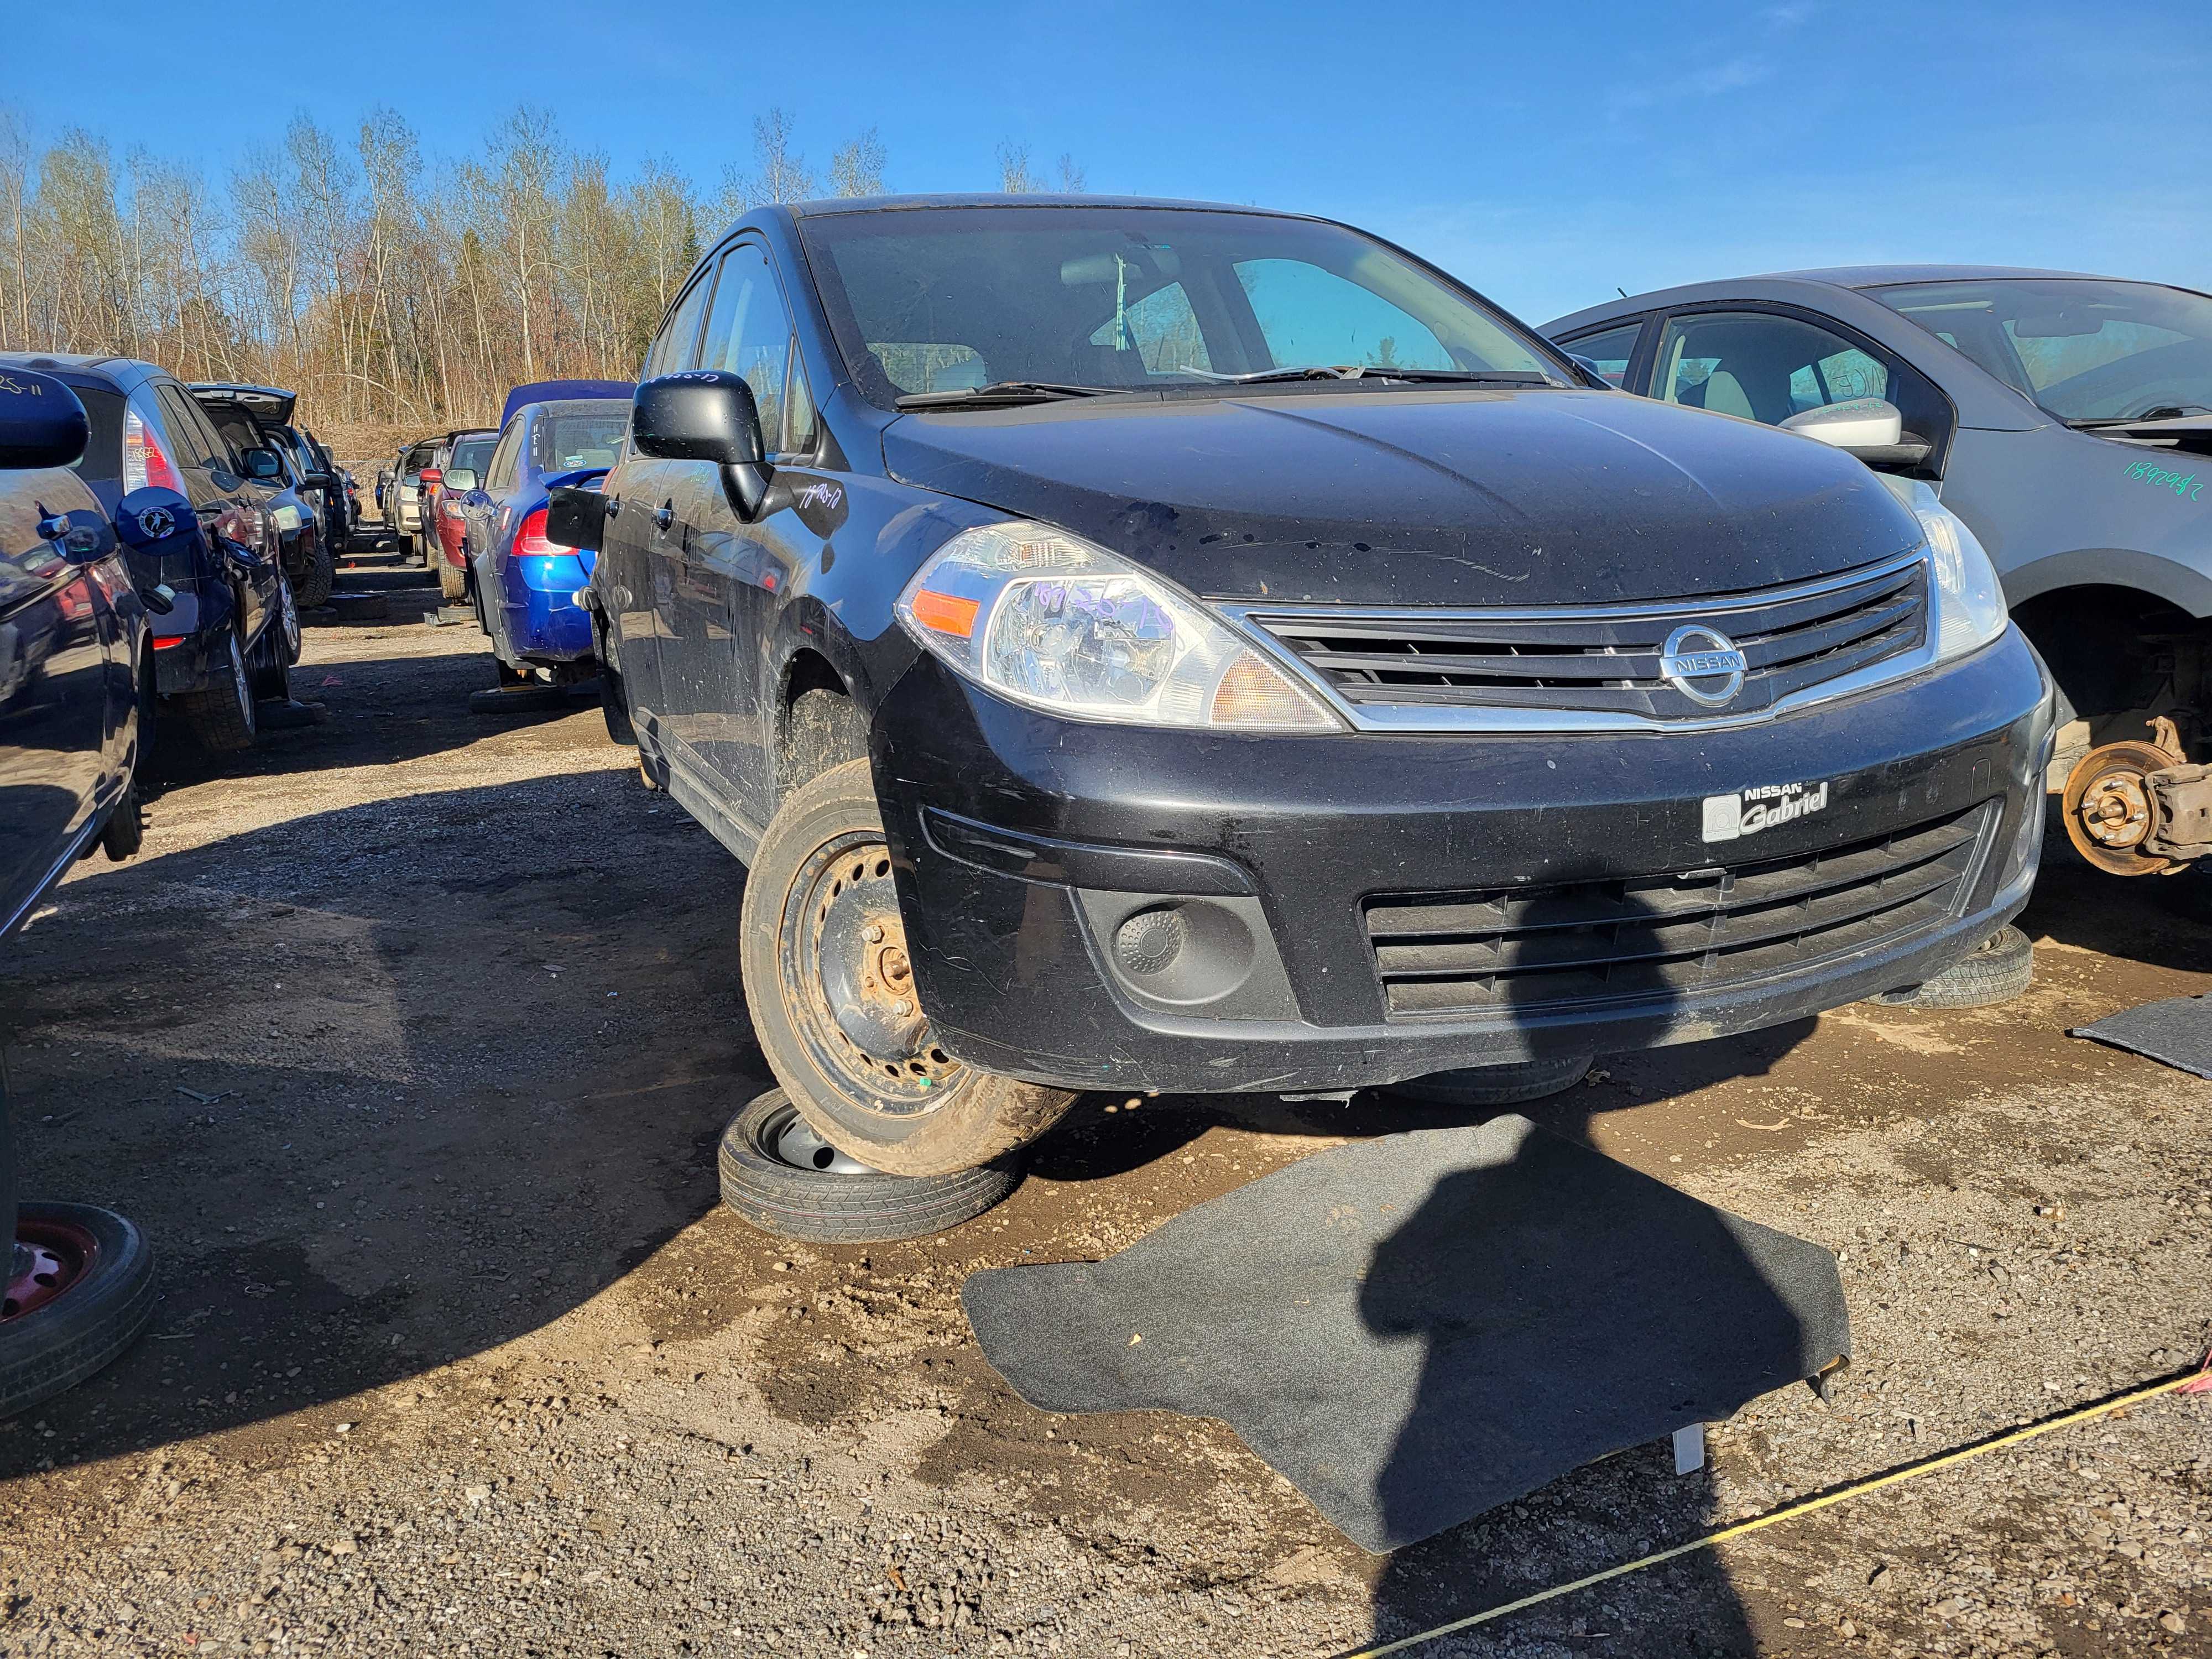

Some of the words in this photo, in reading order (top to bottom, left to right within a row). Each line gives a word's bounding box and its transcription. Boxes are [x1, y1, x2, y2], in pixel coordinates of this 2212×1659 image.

[1674, 654, 1741, 673] NISSAN
[1744, 782, 1803, 801] NISSAN
[1739, 781, 1828, 836] Gabriel
